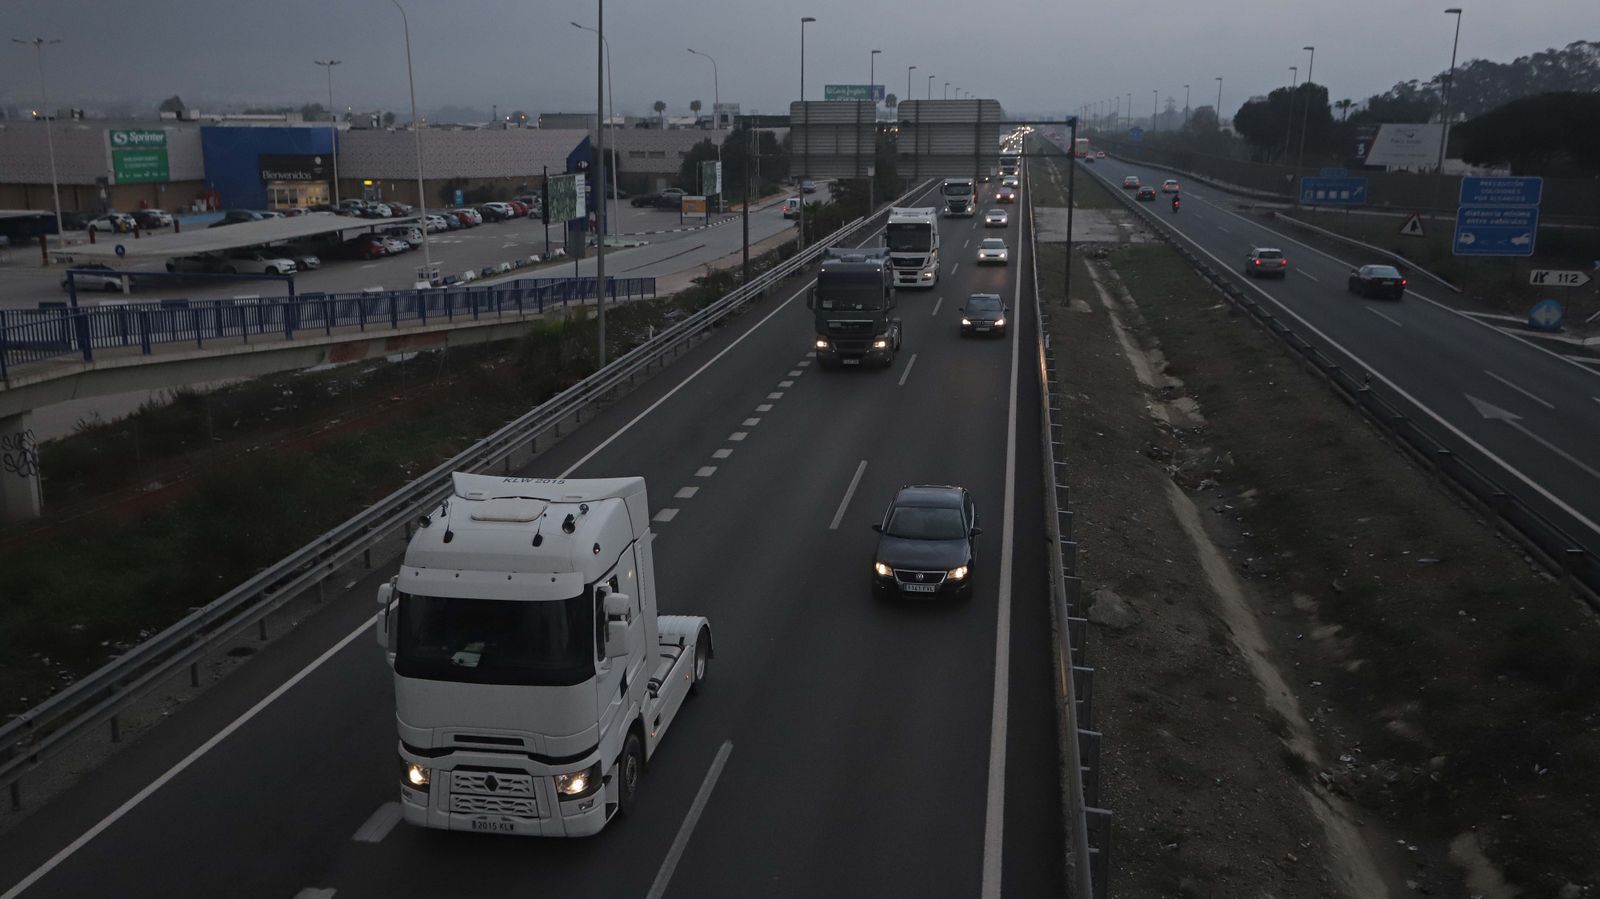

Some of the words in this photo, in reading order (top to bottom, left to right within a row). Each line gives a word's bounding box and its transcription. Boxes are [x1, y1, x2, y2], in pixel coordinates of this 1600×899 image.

[129, 131, 164, 144] Sprinter
[262, 170, 312, 180] Bienvenidos
[1558, 273, 1578, 284] 112
[478, 821, 498, 831] 2015
